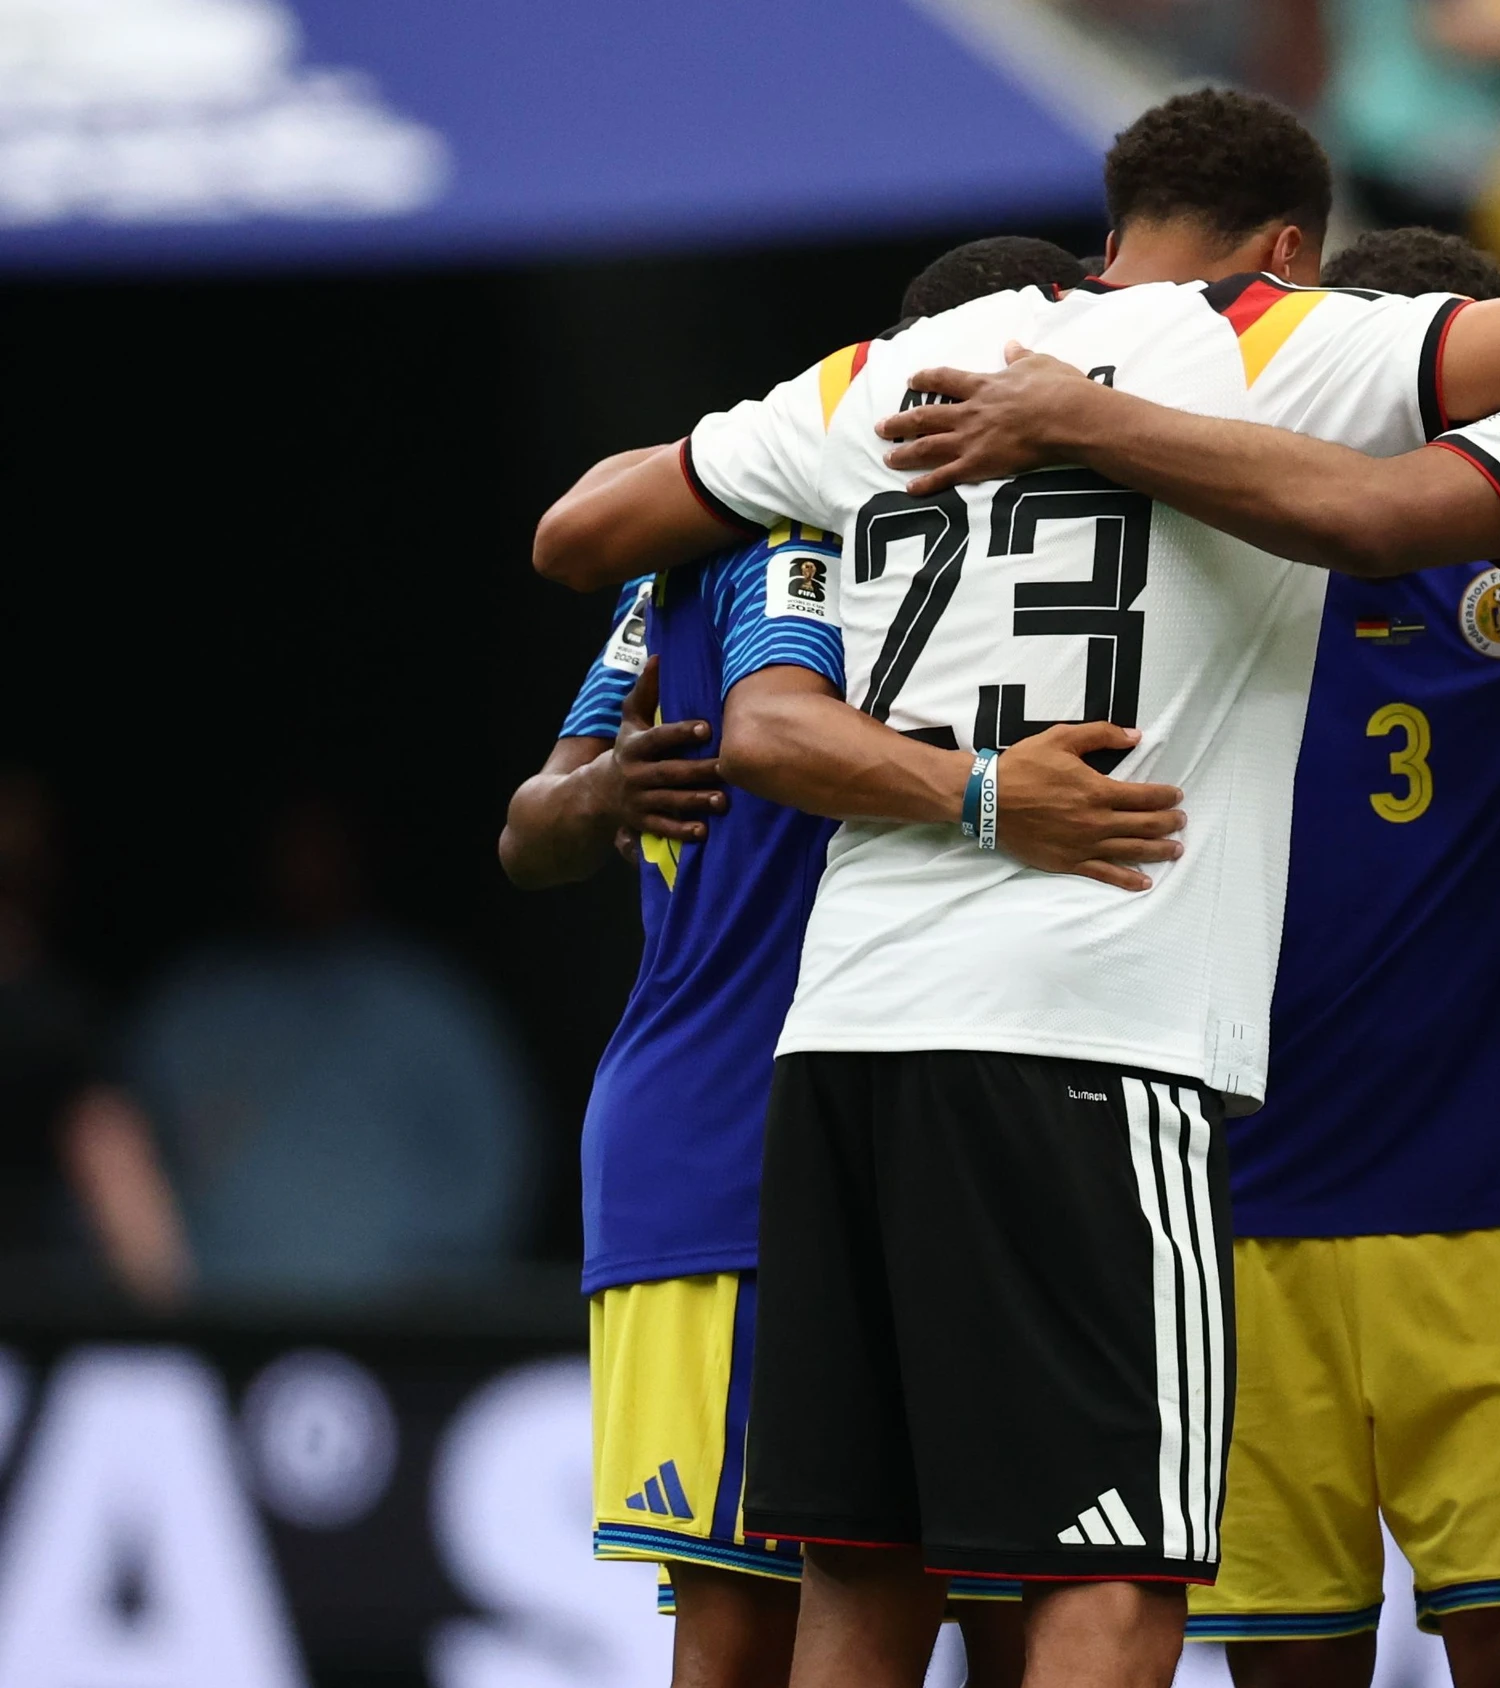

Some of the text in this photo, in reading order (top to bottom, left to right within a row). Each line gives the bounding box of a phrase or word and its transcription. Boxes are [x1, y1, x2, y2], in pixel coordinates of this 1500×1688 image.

[797, 588, 817, 599] FIFA
[786, 604, 825, 617] 2026
[855, 467, 1153, 776] 23
[1366, 702, 1434, 824] 3
[983, 778, 995, 814] GOD
[983, 818, 994, 833] IN
